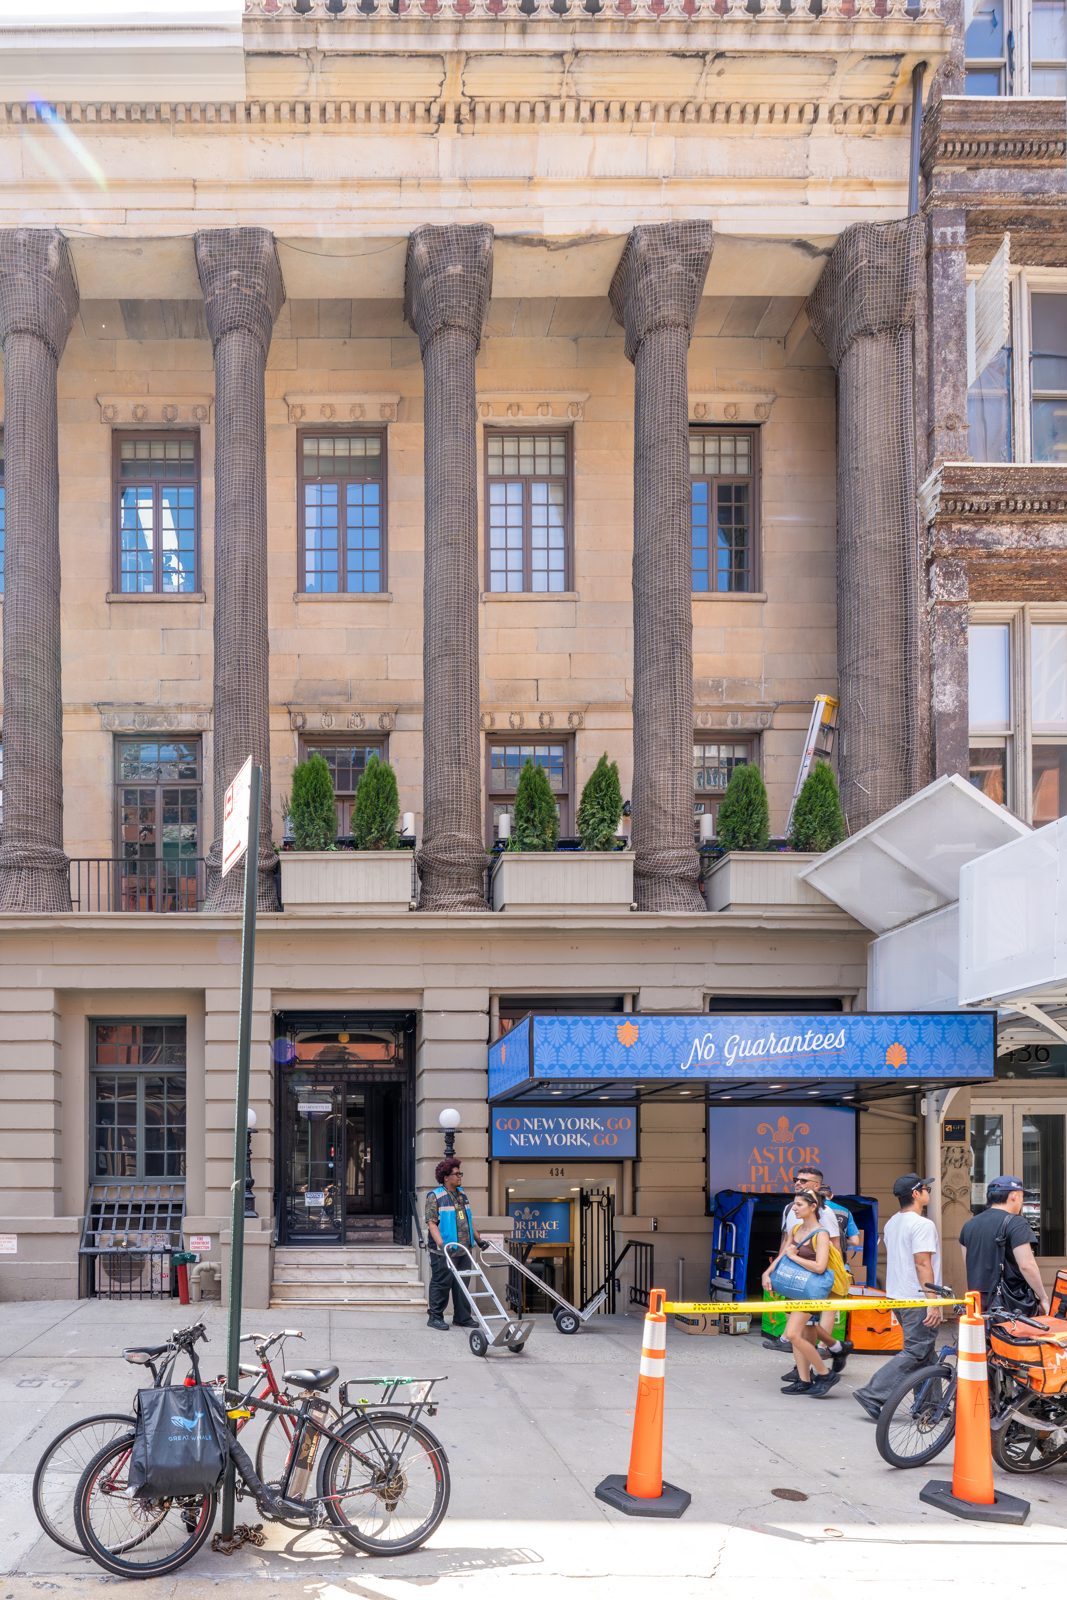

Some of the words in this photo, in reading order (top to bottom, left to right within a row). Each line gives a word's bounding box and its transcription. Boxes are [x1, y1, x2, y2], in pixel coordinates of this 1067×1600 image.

[681, 1032, 715, 1070] No
[724, 1028, 846, 1066] Guarantees
[495, 1117, 521, 1131] GO
[523, 1117, 557, 1131] NEW
[558, 1117, 604, 1132] YORK,
[606, 1117, 631, 1131] GO
[509, 1133, 543, 1147] NEW
[544, 1133, 591, 1148] YORK,
[593, 1133, 618, 1147] GO
[748, 1145, 821, 1164] ASTOR
[549, 1167, 565, 1177] 434
[751, 1165, 815, 1183] PLAC
[528, 1220, 559, 1230] PLACE
[511, 1230, 549, 1239] HEATRE
